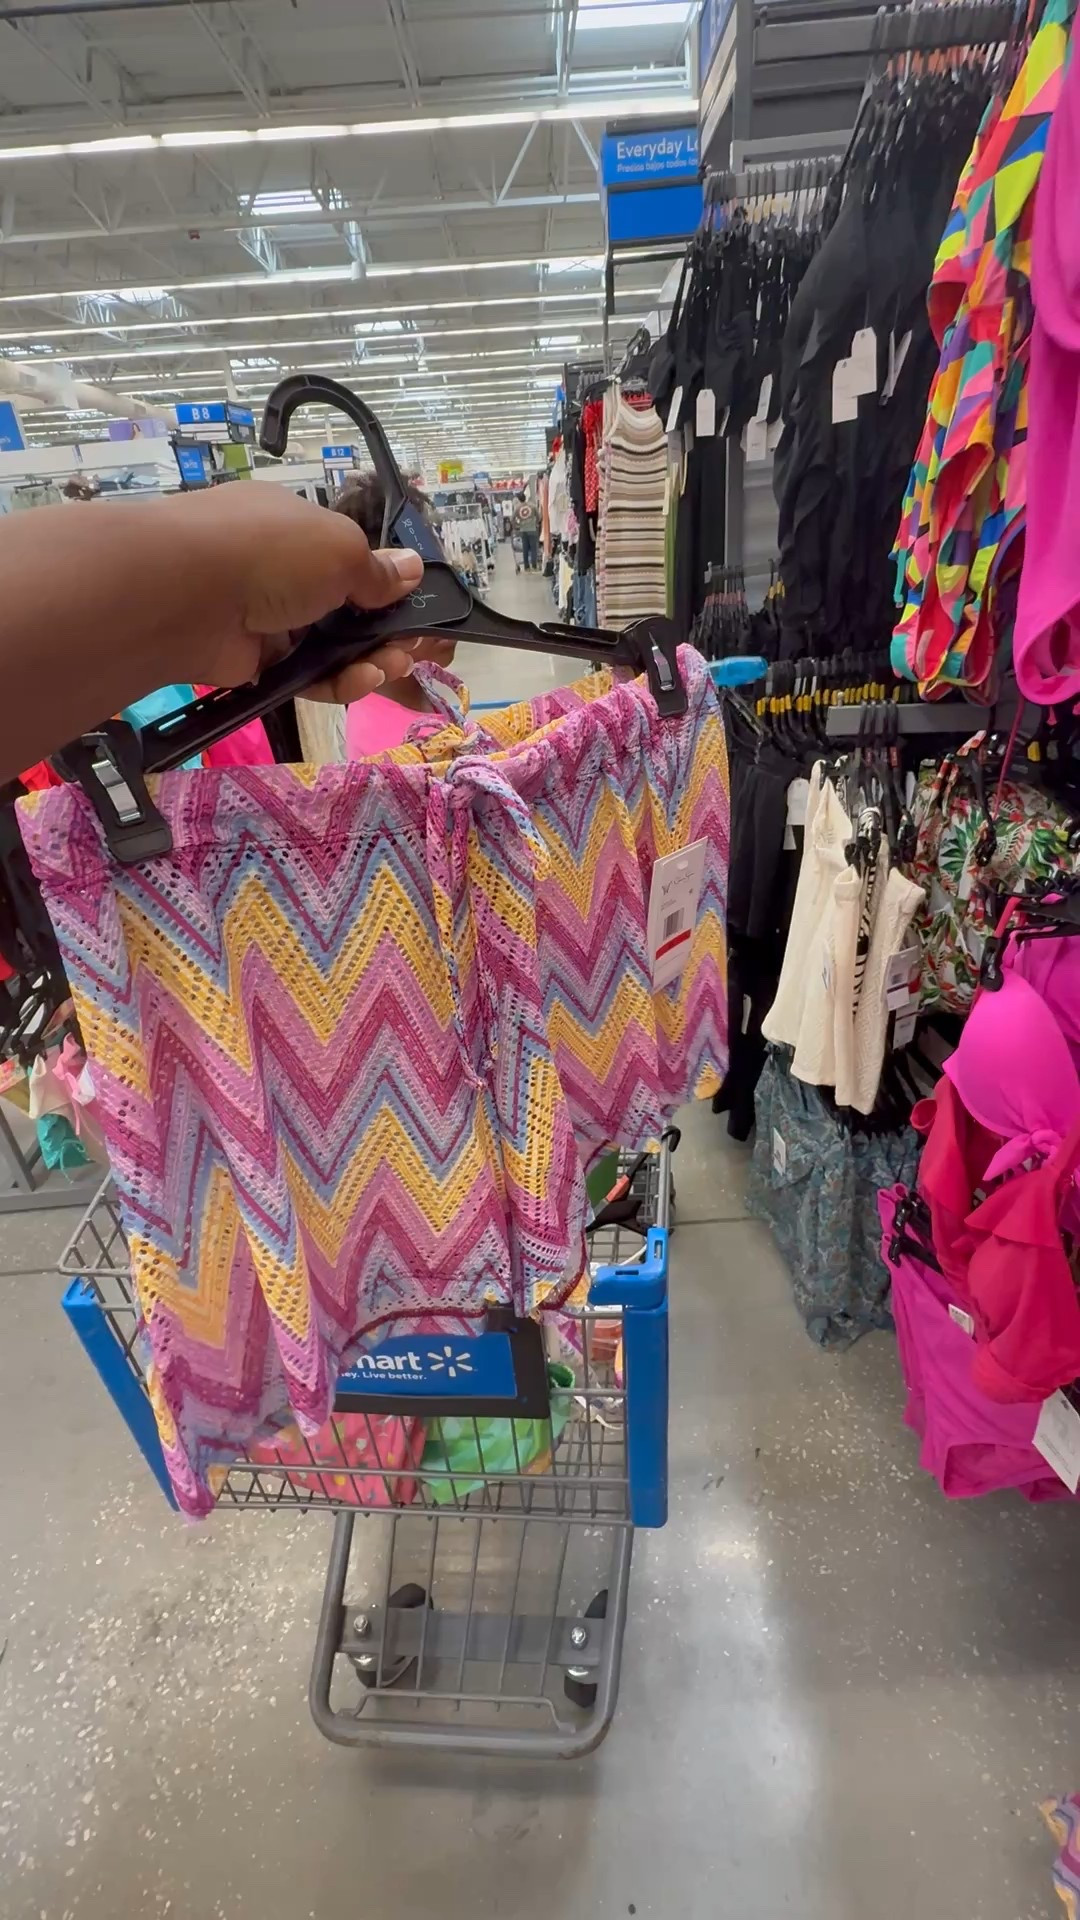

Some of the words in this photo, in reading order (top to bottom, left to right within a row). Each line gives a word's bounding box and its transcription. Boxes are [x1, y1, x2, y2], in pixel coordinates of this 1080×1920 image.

[617, 137, 682, 160] Everyday
[617, 163, 645, 172] Precios
[645, 161, 665, 172] bajos
[666, 159, 687, 168] todos
[362, 1371, 386, 1379] Live
[387, 1372, 427, 1380] better.
